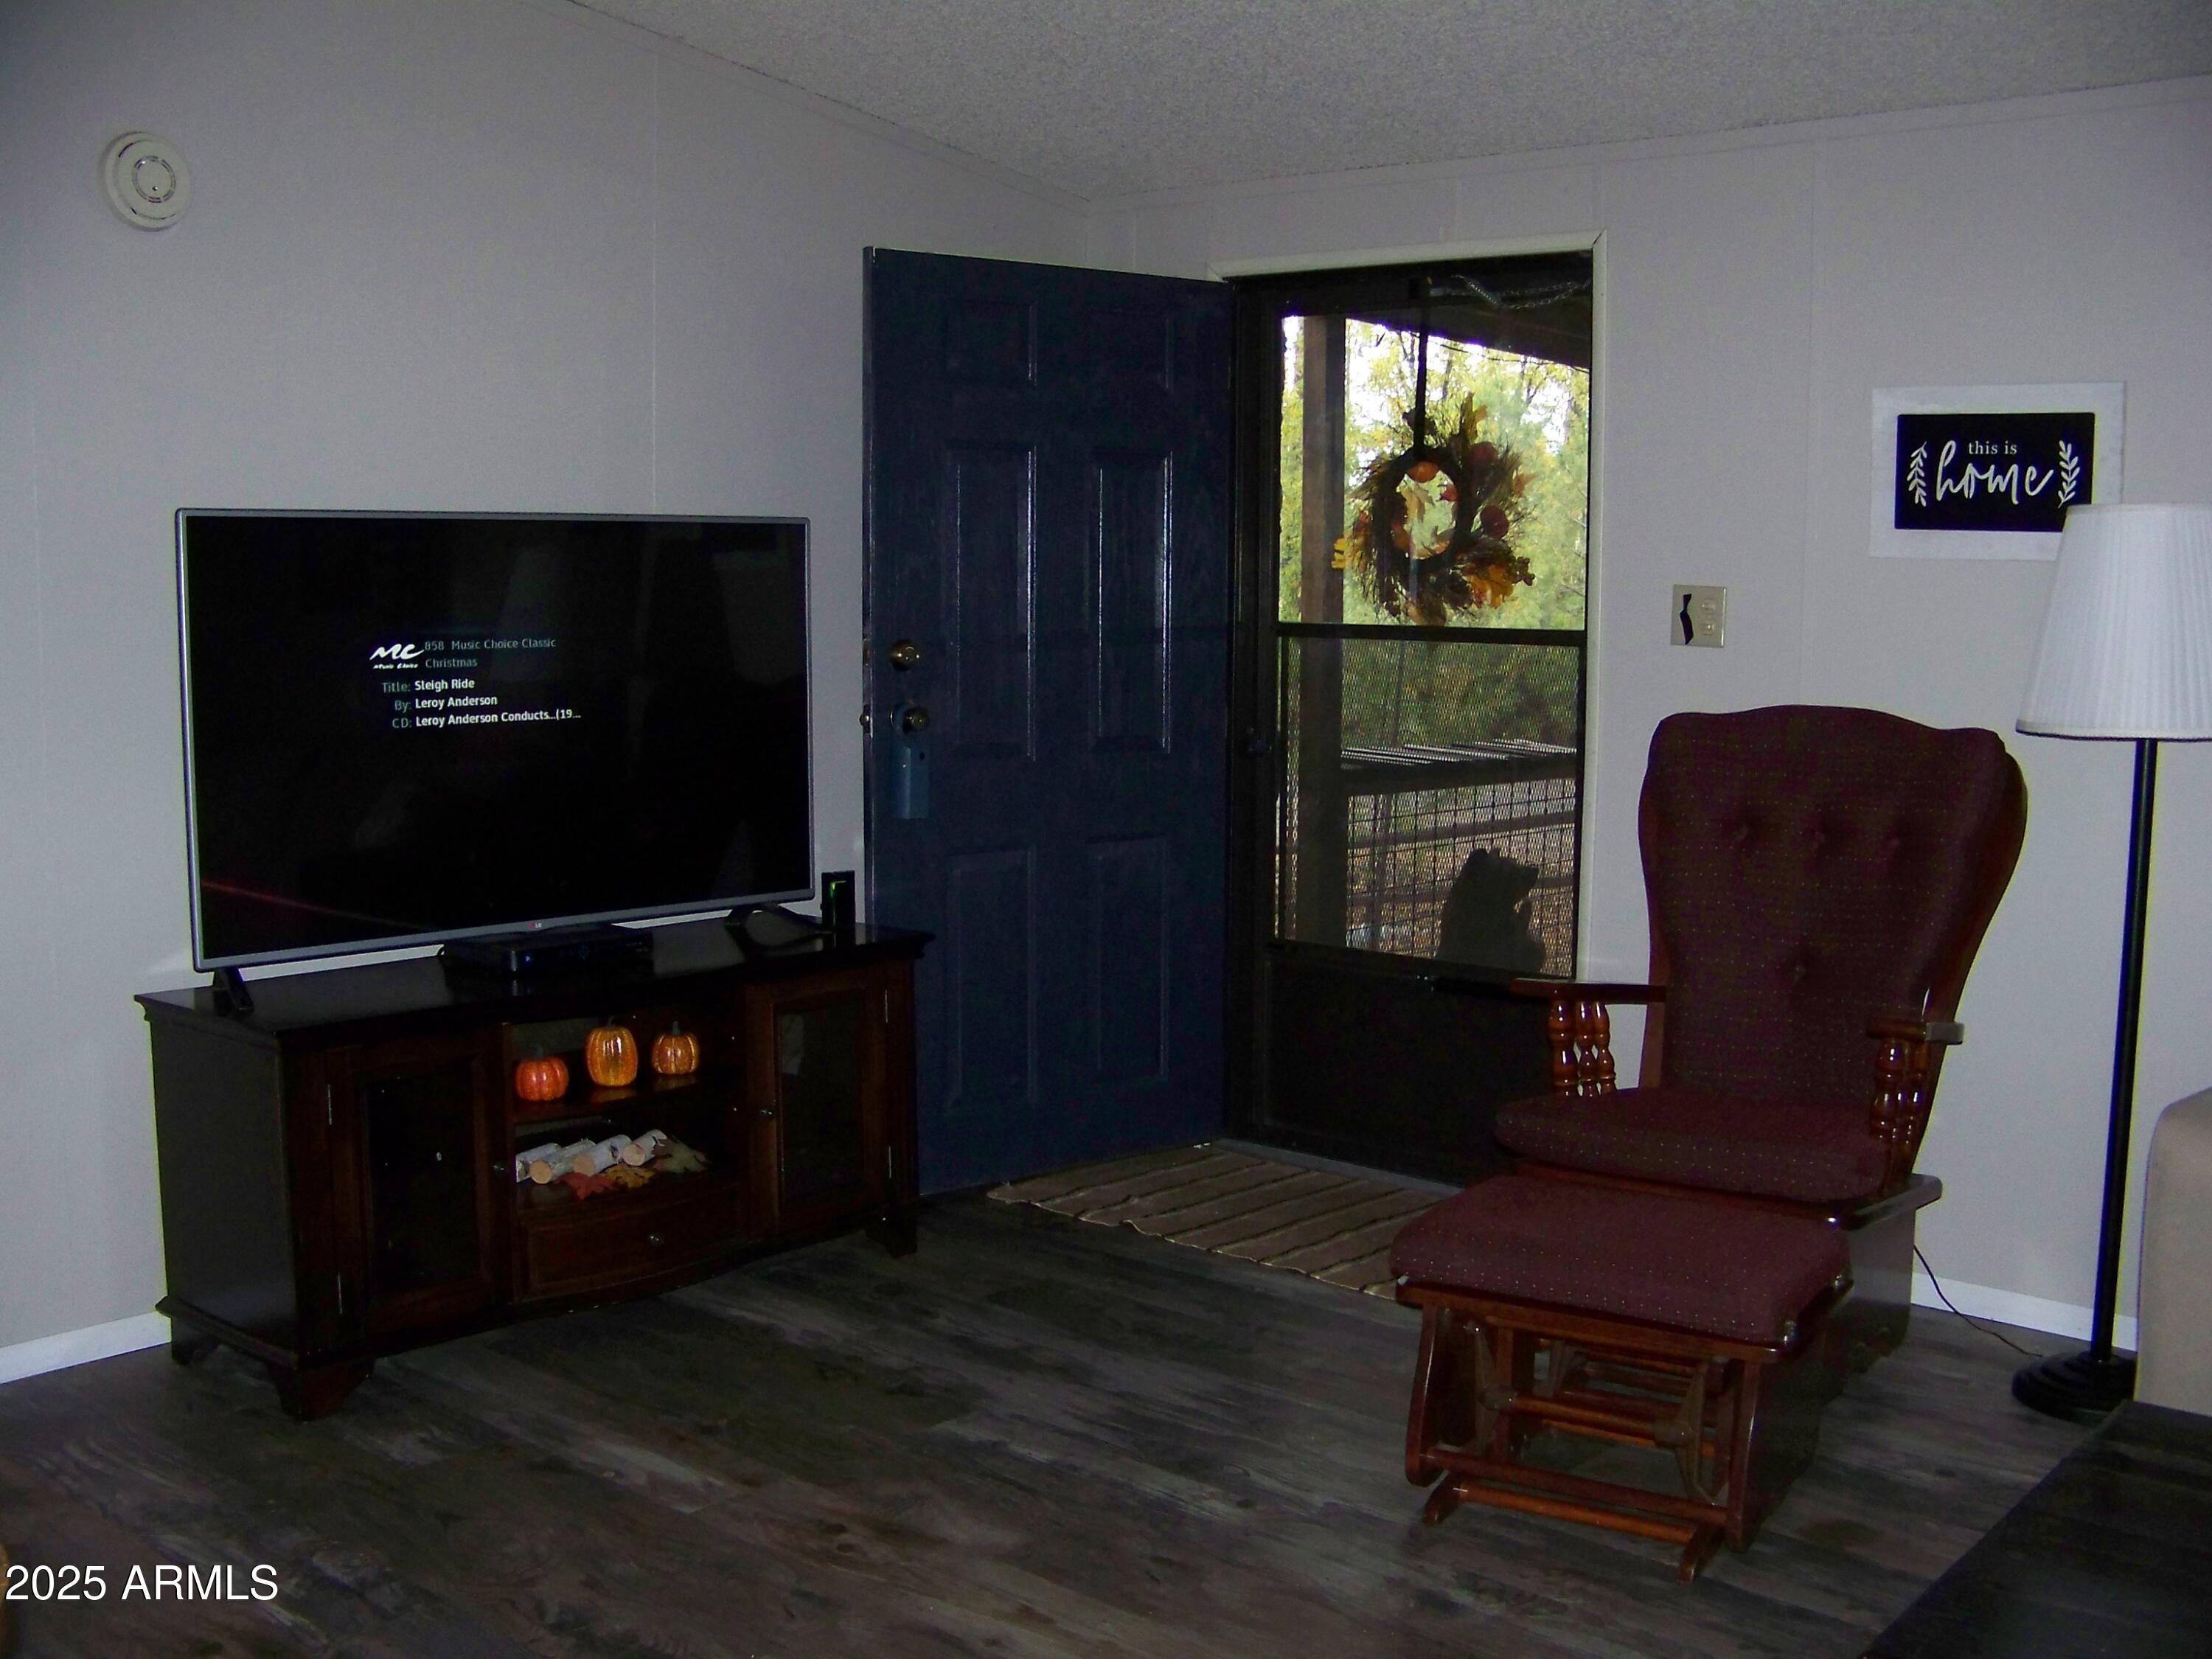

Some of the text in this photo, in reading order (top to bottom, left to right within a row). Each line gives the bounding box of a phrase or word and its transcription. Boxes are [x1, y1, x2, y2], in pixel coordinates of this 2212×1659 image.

[1968, 441, 2017, 455] this is
[1935, 440, 2054, 505] home
[451, 639, 481, 650] Music
[484, 638, 519, 650] Choice
[521, 638, 557, 648] Classic
[425, 658, 479, 669] Christmas
[382, 678, 476, 694] Title: Sleigh Ride
[394, 696, 498, 713] By: Leroy Anderson
[392, 717, 412, 729] CD:
[416, 714, 445, 728] Leroy
[448, 712, 498, 725] Anderson
